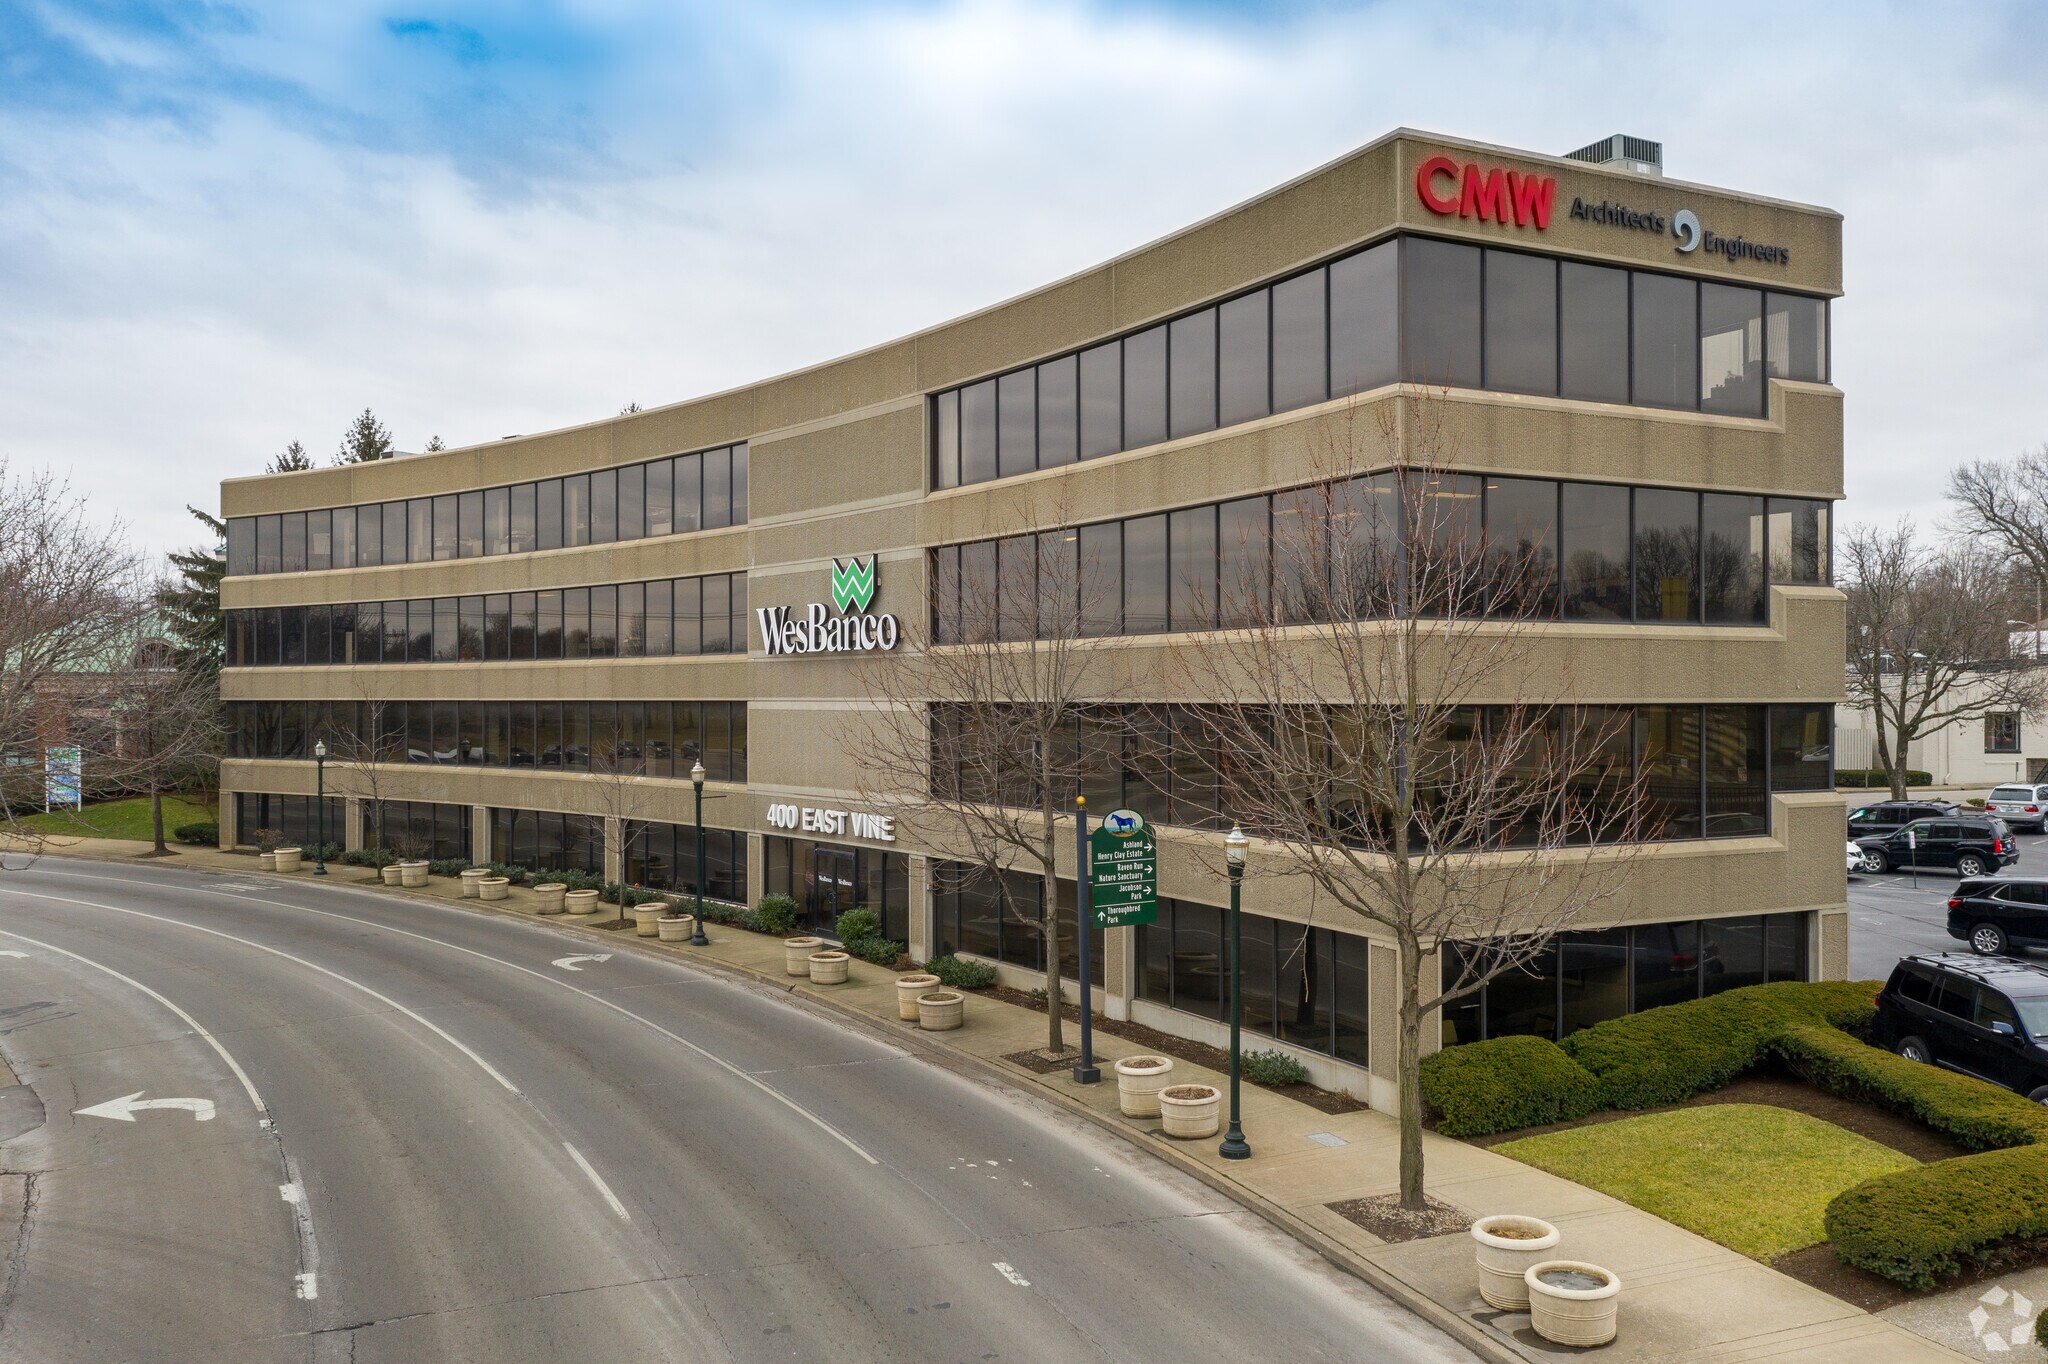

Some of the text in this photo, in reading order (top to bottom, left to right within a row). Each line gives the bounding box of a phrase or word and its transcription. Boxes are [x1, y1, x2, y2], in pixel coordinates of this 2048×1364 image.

[1417, 156, 1555, 229] CMW
[1571, 197, 1665, 233] Architects
[1704, 231, 1789, 264] Engineers
[756, 603, 901, 655] WesBanco
[767, 804, 896, 841] 400 EAST VINE
[1123, 841, 1143, 849] Ashland
[1097, 850, 1143, 861] Henry Clay Estate
[1117, 862, 1143, 871] Raven Run
[1099, 872, 1143, 882] Nature Sanctuary
[1119, 884, 1142, 892] Jacobson
[1130, 892, 1142, 900] Park
[1107, 905, 1141, 915] Thoroughbred
[1107, 916, 1119, 924] Park
